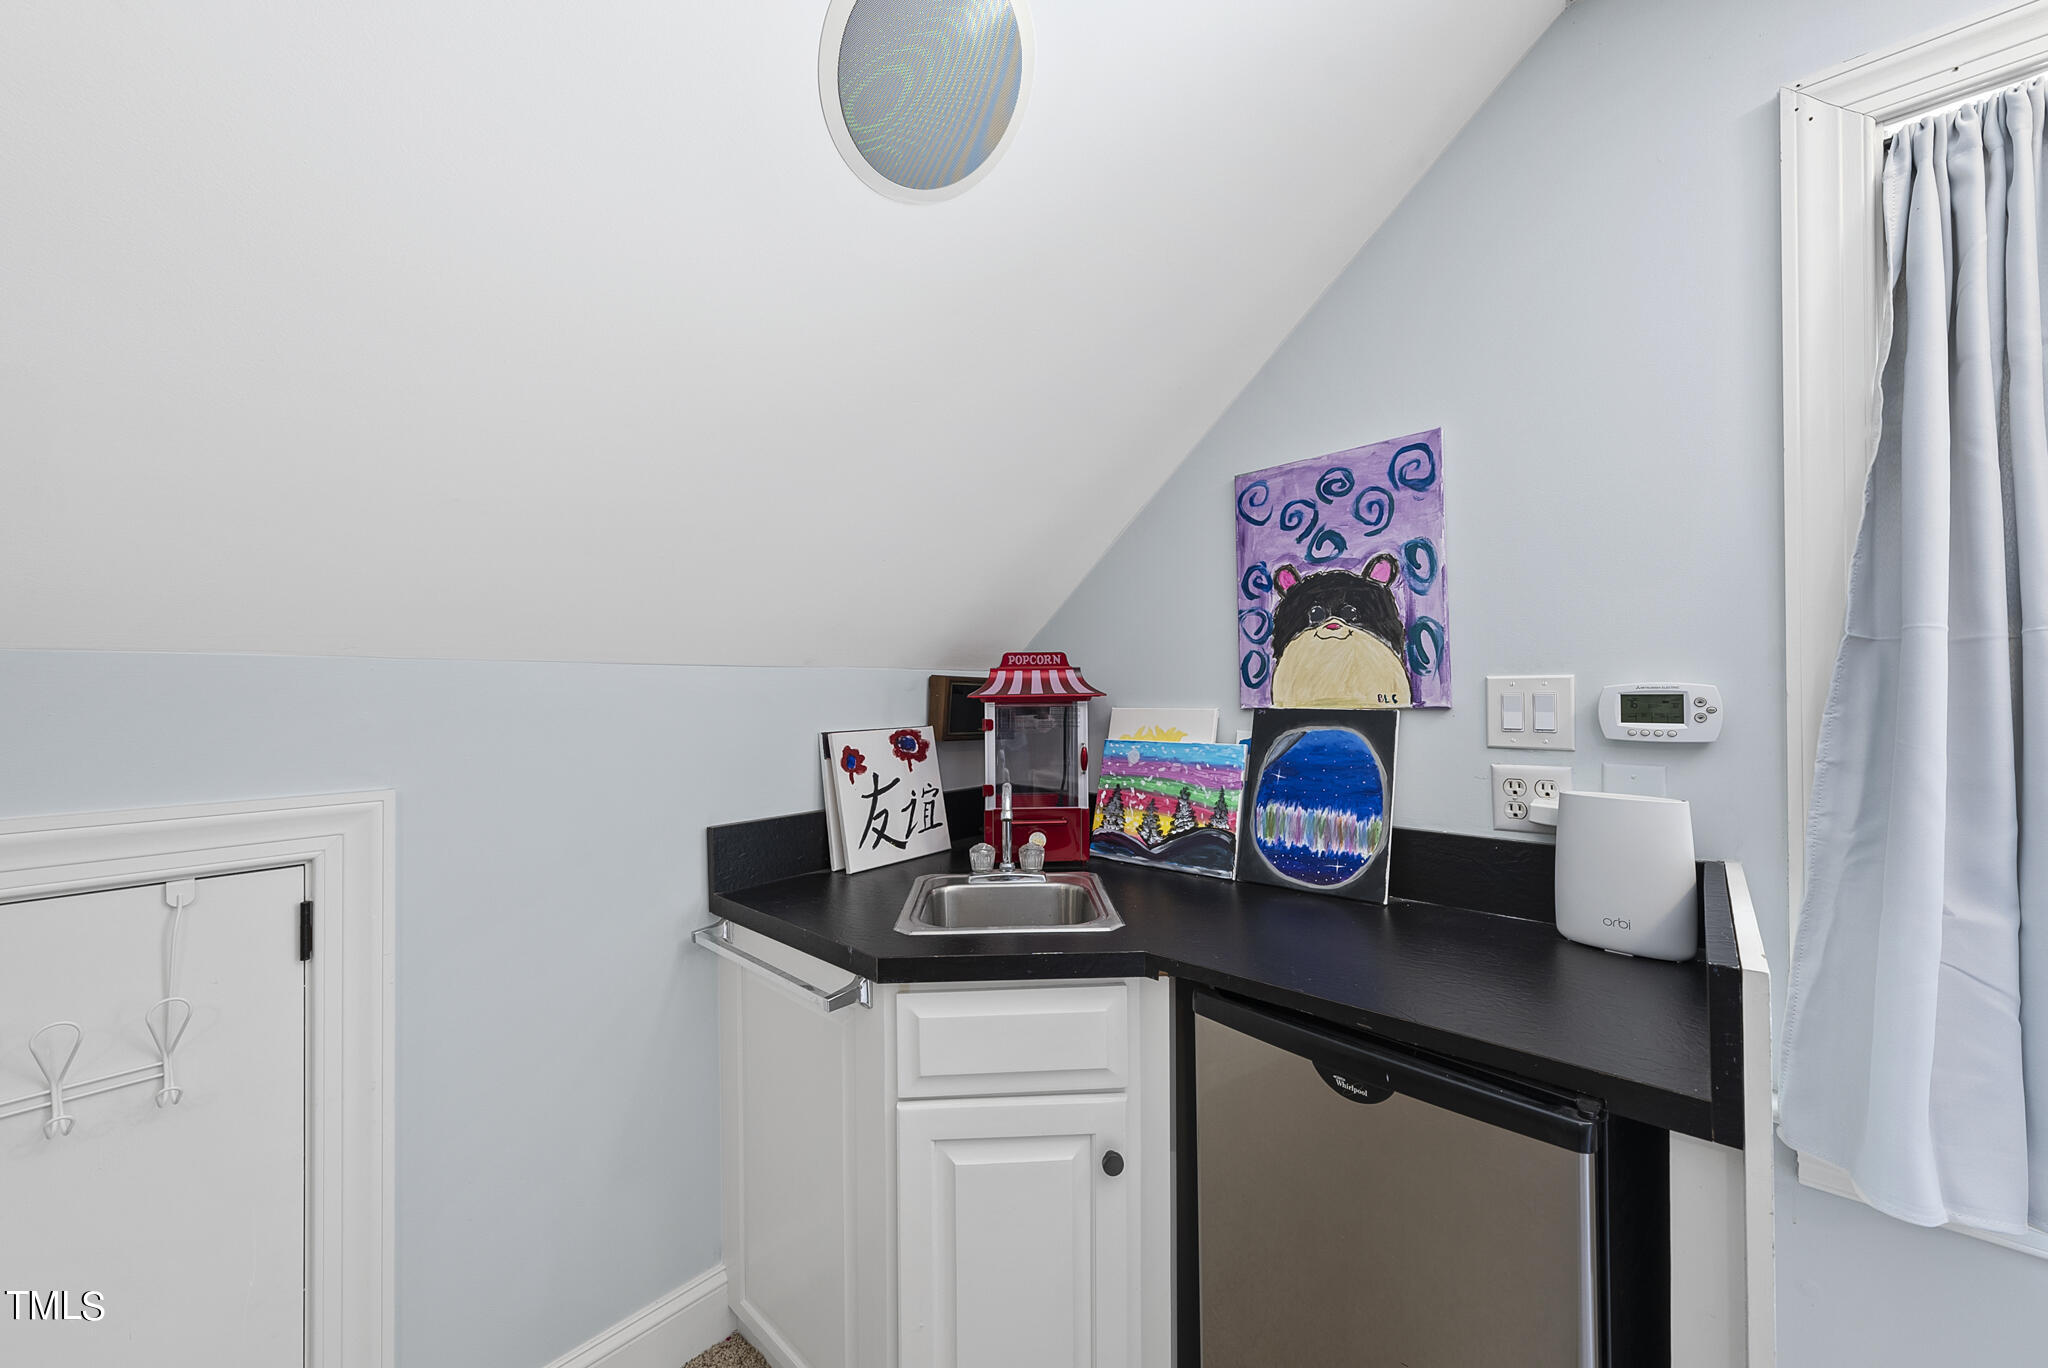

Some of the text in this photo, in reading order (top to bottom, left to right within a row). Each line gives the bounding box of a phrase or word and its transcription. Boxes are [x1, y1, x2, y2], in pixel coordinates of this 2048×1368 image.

[1008, 654, 1061, 665] POPCORN
[858, 772, 943, 850] 友谊
[1602, 917, 1631, 931] orbi
[1335, 1079, 1368, 1097] Whirlpool
